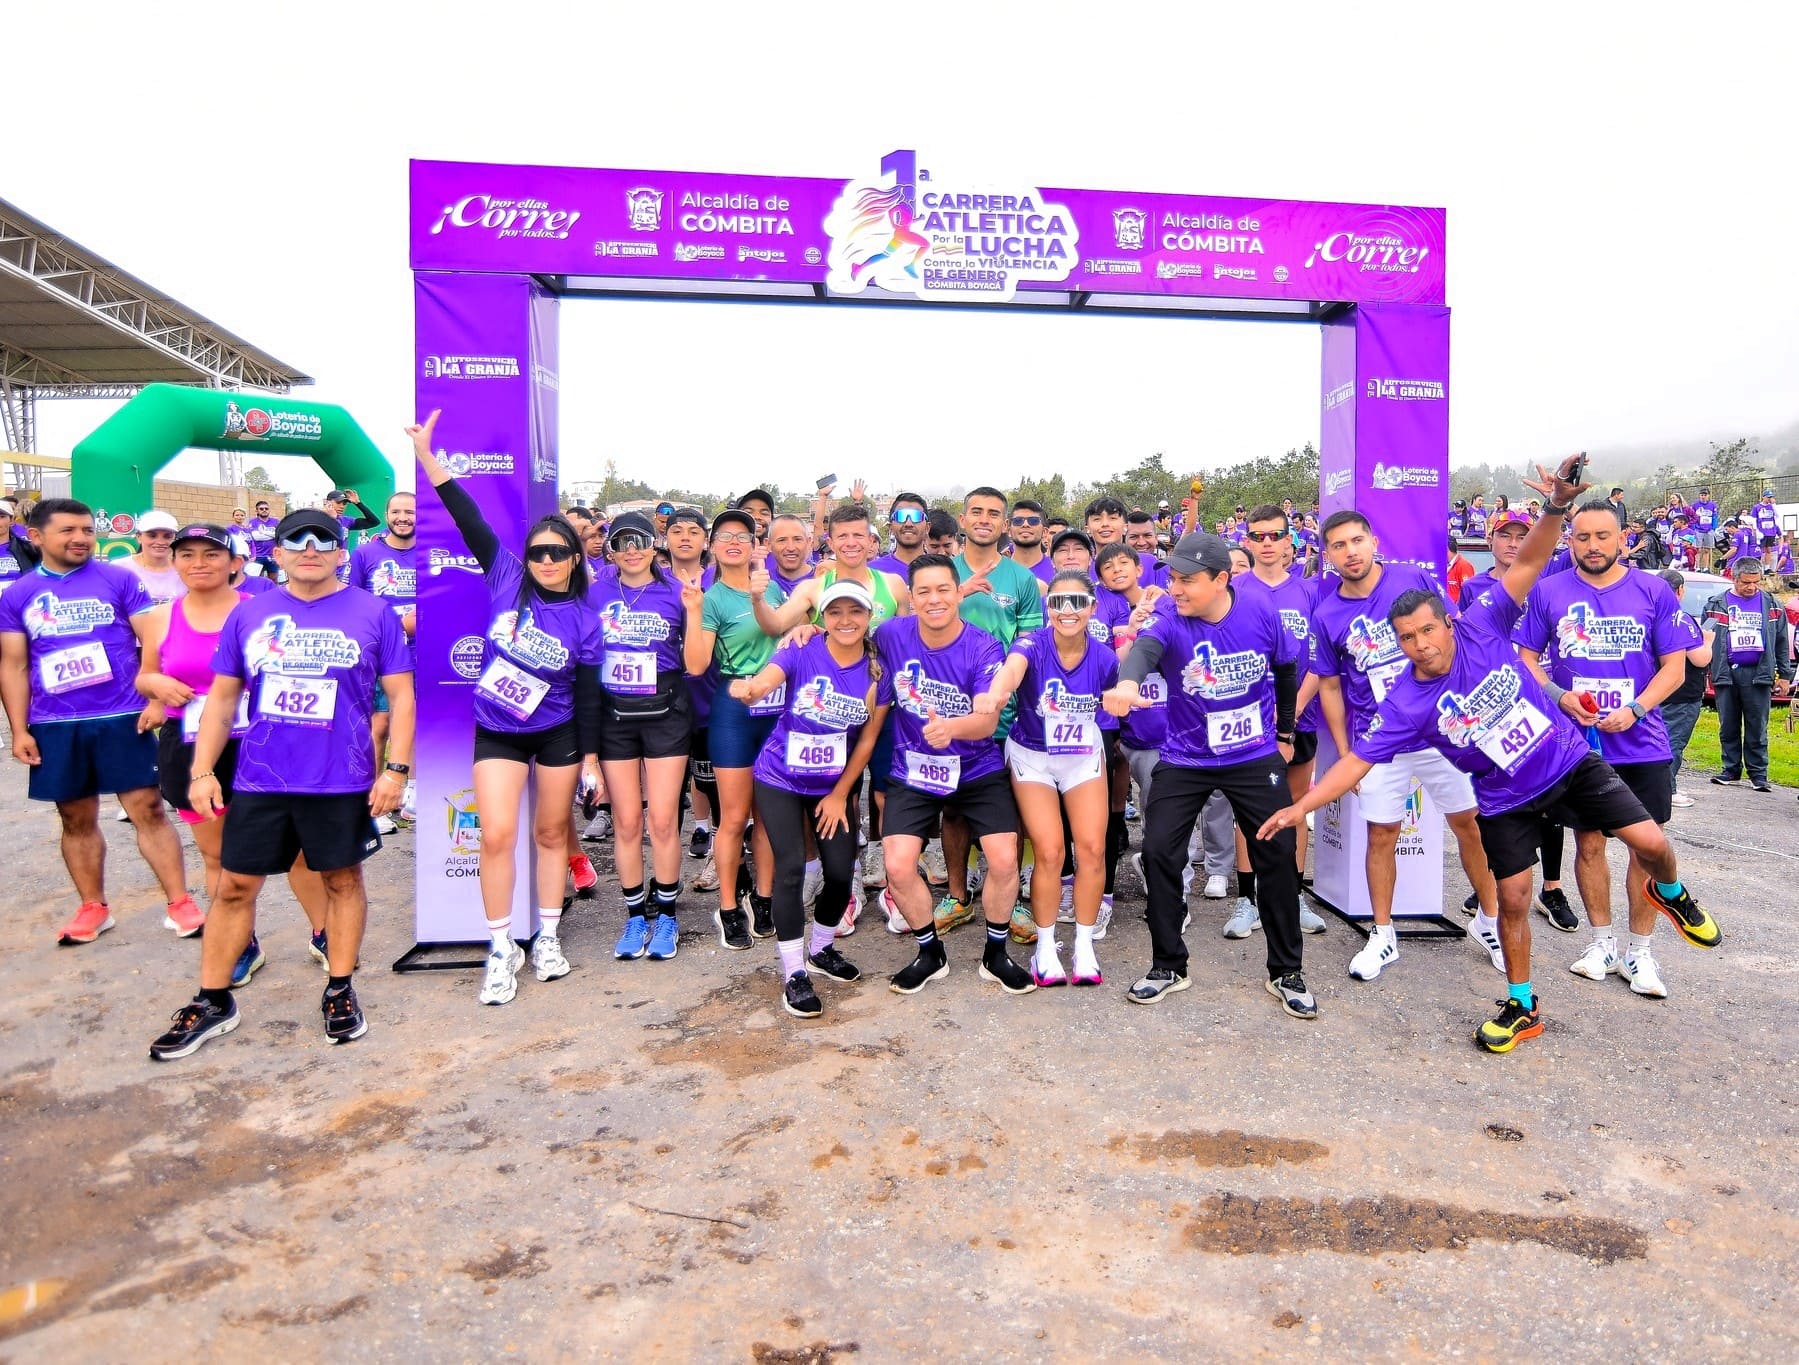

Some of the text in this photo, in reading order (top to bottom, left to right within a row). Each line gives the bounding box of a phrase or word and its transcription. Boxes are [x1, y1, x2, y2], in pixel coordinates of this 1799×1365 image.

[489, 199, 548, 210] por ellas
[681, 192, 790, 211] Alcaldía de
[922, 193, 1035, 212] CARRERA
[431, 194, 581, 240] ¡Corre!
[682, 210, 795, 235] CÓMBITA
[923, 208, 1068, 236] ATLÉTICA
[1162, 213, 1260, 232] Alcaldía de
[499, 229, 521, 240] por
[933, 234, 964, 244] Por la
[1352, 236, 1402, 246] por ellas
[965, 236, 1068, 259] LUCHA
[1162, 232, 1265, 255] CÓMBITA
[1304, 232, 1429, 273] ¡Corre!
[924, 258, 962, 268] Contra
[966, 259, 976, 268] la
[924, 268, 946, 280] DE
[442, 363, 520, 375] LA GRANJA
[1381, 385, 1395, 396] LA
[1400, 386, 1444, 398] GRANJA
[309, 415, 320, 423] de
[471, 459, 514, 470] Boyacá
[430, 554, 479, 567] anto
[53, 601, 98, 610] CARRERA
[72, 612, 113, 621] LUCHA
[1588, 619, 1633, 627] CARRERA
[285, 632, 342, 640] CARRERA
[526, 625, 559, 647] CARRERA
[633, 626, 668, 636] LUCHA
[1738, 635, 1756, 646] 097
[304, 648, 355, 660] LUCHA
[530, 644, 564, 666] LUCHA
[1212, 653, 1255, 666] CARRERA
[55, 656, 96, 681] 296
[612, 663, 643, 683] 451
[494, 675, 532, 705] 453
[921, 680, 958, 694] CARRERA
[1140, 683, 1160, 700] 46
[1463, 673, 1499, 710] CARRERA
[1488, 674, 1516, 710] LUCHA
[274, 690, 320, 715] 432
[826, 693, 863, 707] CARRERA
[836, 709, 867, 721] LUCHA
[1053, 723, 1083, 743] 474
[1220, 717, 1252, 742] 246
[1500, 716, 1535, 755] 437
[799, 745, 835, 765] 469
[919, 763, 950, 783] 468
[1411, 836, 1423, 844] de
[445, 856, 480, 865] Alcald
